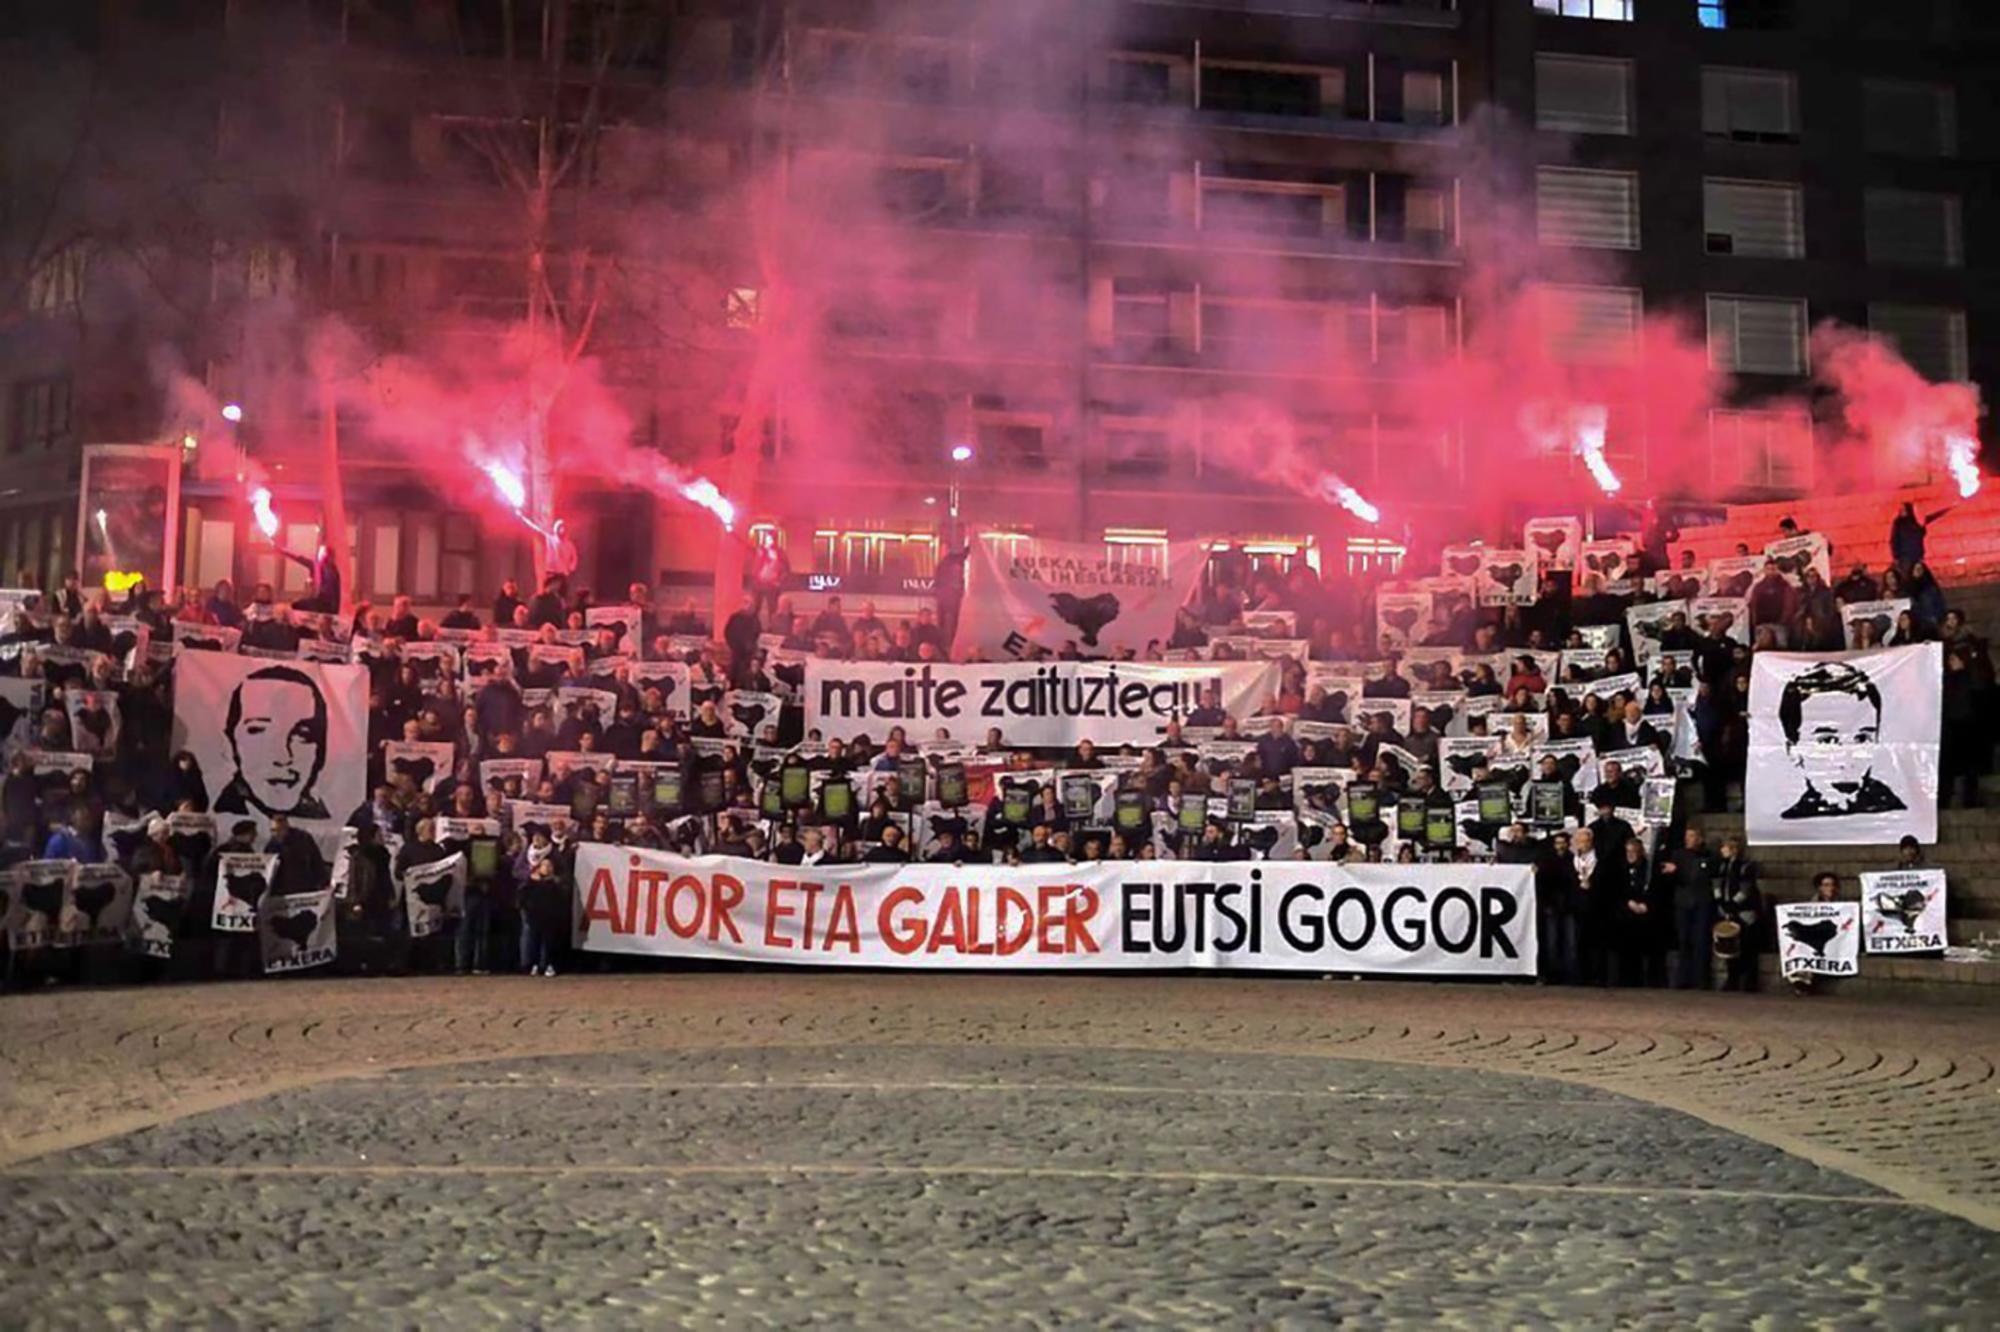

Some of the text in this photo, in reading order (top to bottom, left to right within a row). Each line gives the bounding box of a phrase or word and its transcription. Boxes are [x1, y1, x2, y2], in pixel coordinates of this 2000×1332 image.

[819, 665, 967, 719] maite
[763, 879, 861, 954] ETA
[877, 883, 1100, 956] GALDER
[1277, 882, 1520, 959] GOGOR
[1871, 933, 1942, 950] ETXERA
[1785, 957, 1853, 973] ETXERA
